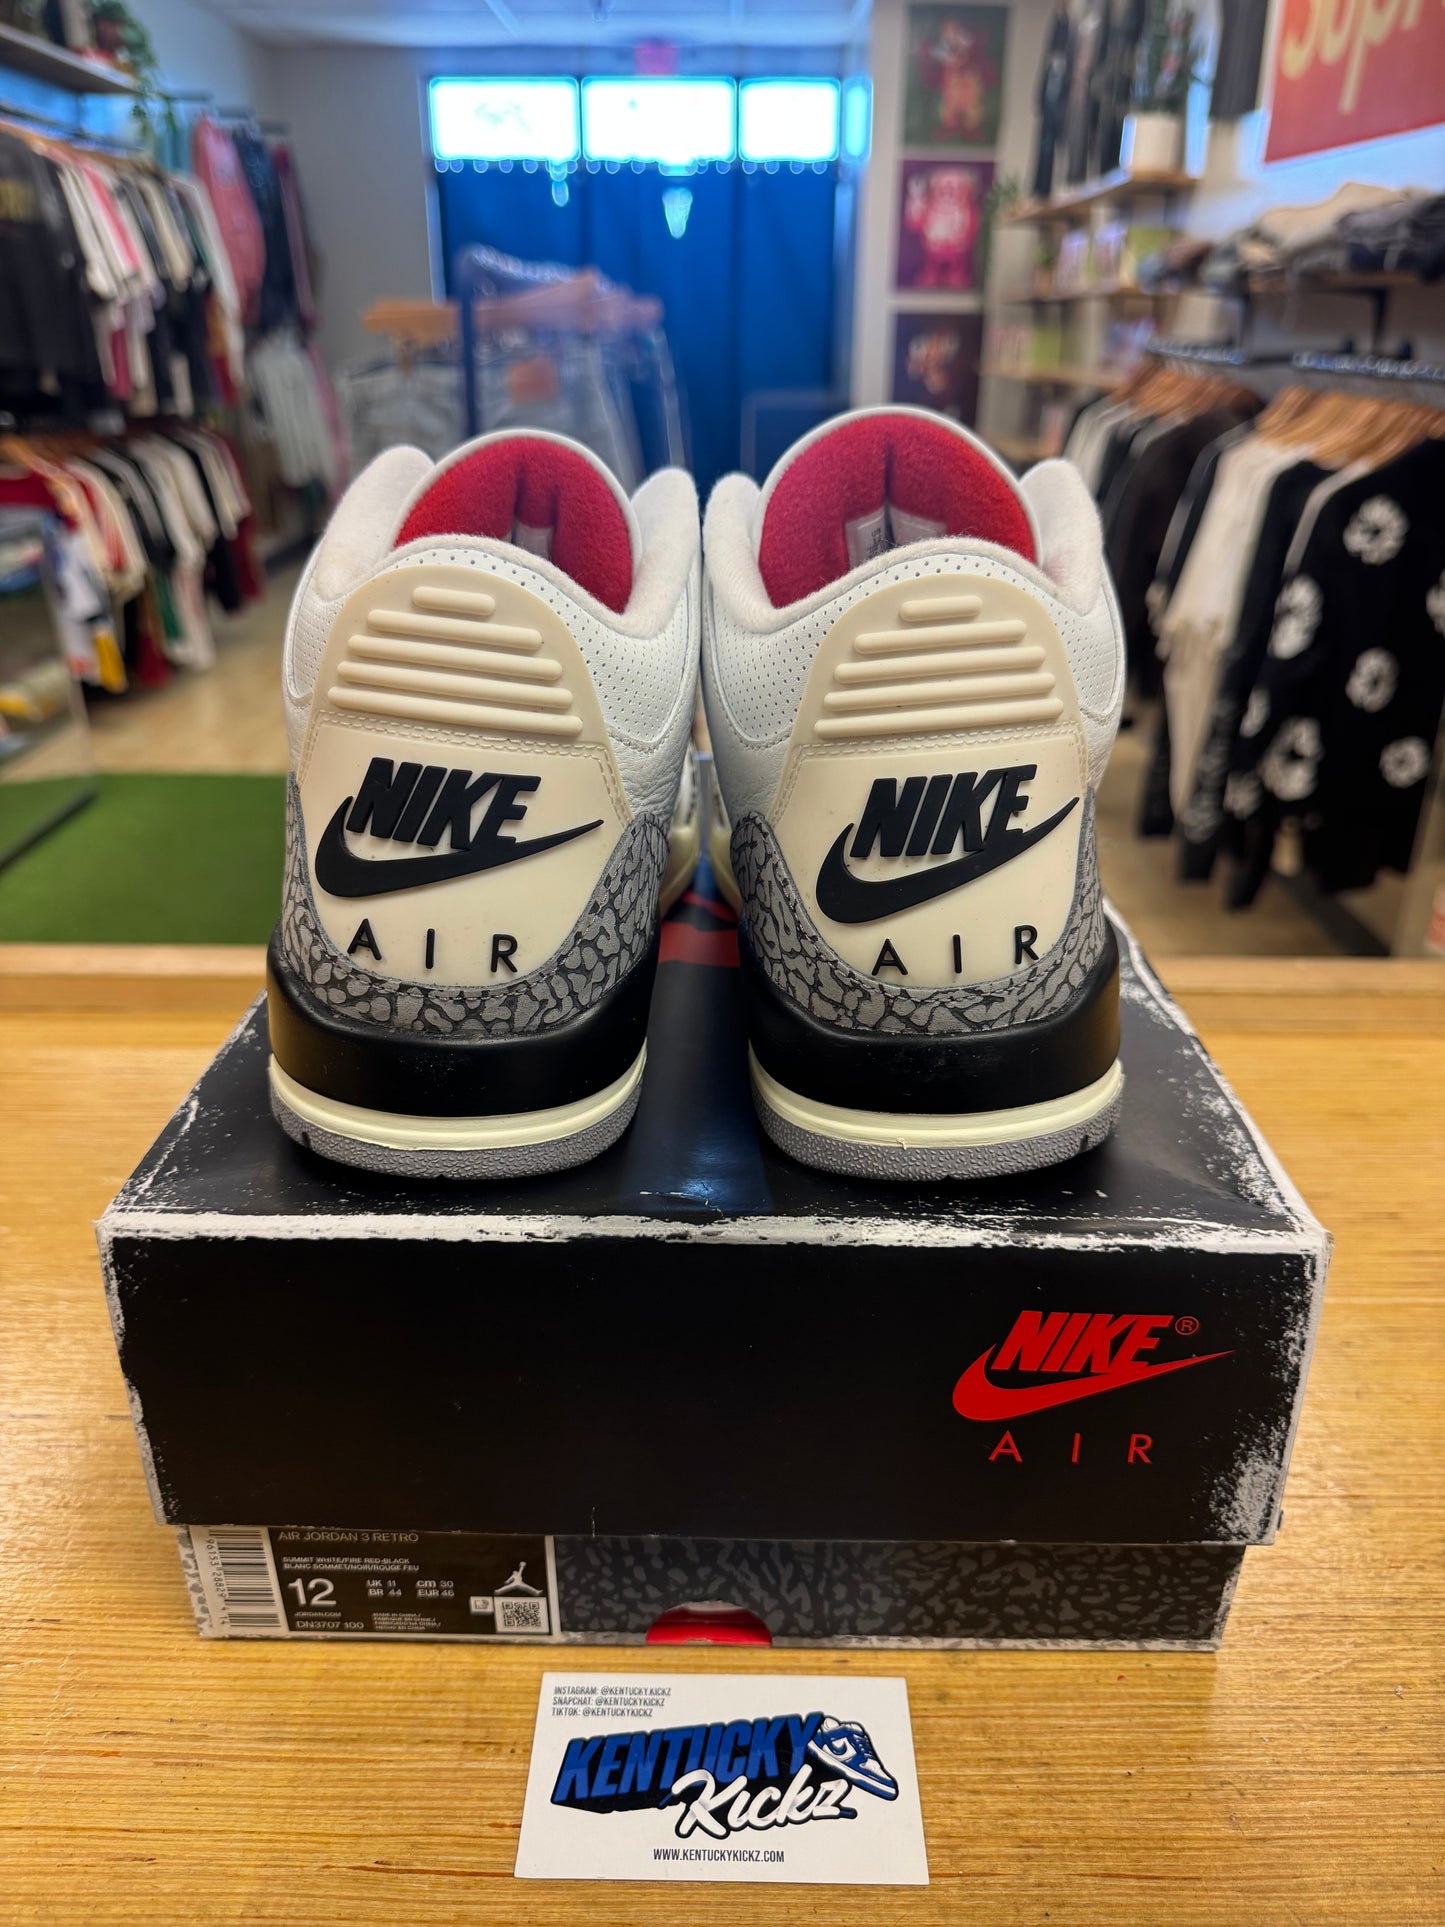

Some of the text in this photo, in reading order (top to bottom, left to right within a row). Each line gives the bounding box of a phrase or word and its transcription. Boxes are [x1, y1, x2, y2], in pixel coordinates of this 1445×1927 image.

[346, 757, 541, 851] NIKE
[850, 764, 1037, 858] NIKE
[347, 918, 518, 973] AIR
[872, 925, 1039, 976] AIR
[990, 1310, 1174, 1373] NIKE
[988, 1430, 1153, 1464] AIR
[279, 1531, 419, 1542] AIR JORDAN 3 RETRO
[367, 1580, 383, 1588] UK
[417, 1580, 454, 1588] cm 30
[288, 1577, 337, 1606] 12
[368, 1589, 384, 1597] BR
[418, 1589, 439, 1598] EUR
[296, 1621, 365, 1630] DN3707 100
[554, 1686, 599, 1695] INSTAGRAM:
[552, 1697, 665, 1706] SNAPCHAT: @KENTUCKYKICKZ
[551, 1707, 653, 1717] TIKTOK: @KENTUCKYKICKZ
[551, 1713, 823, 1802] KENTUCKY
[671, 1764, 848, 1836] Kickz
[653, 1848, 785, 1862] WWW.KENTUCKYKICKZ.COM
